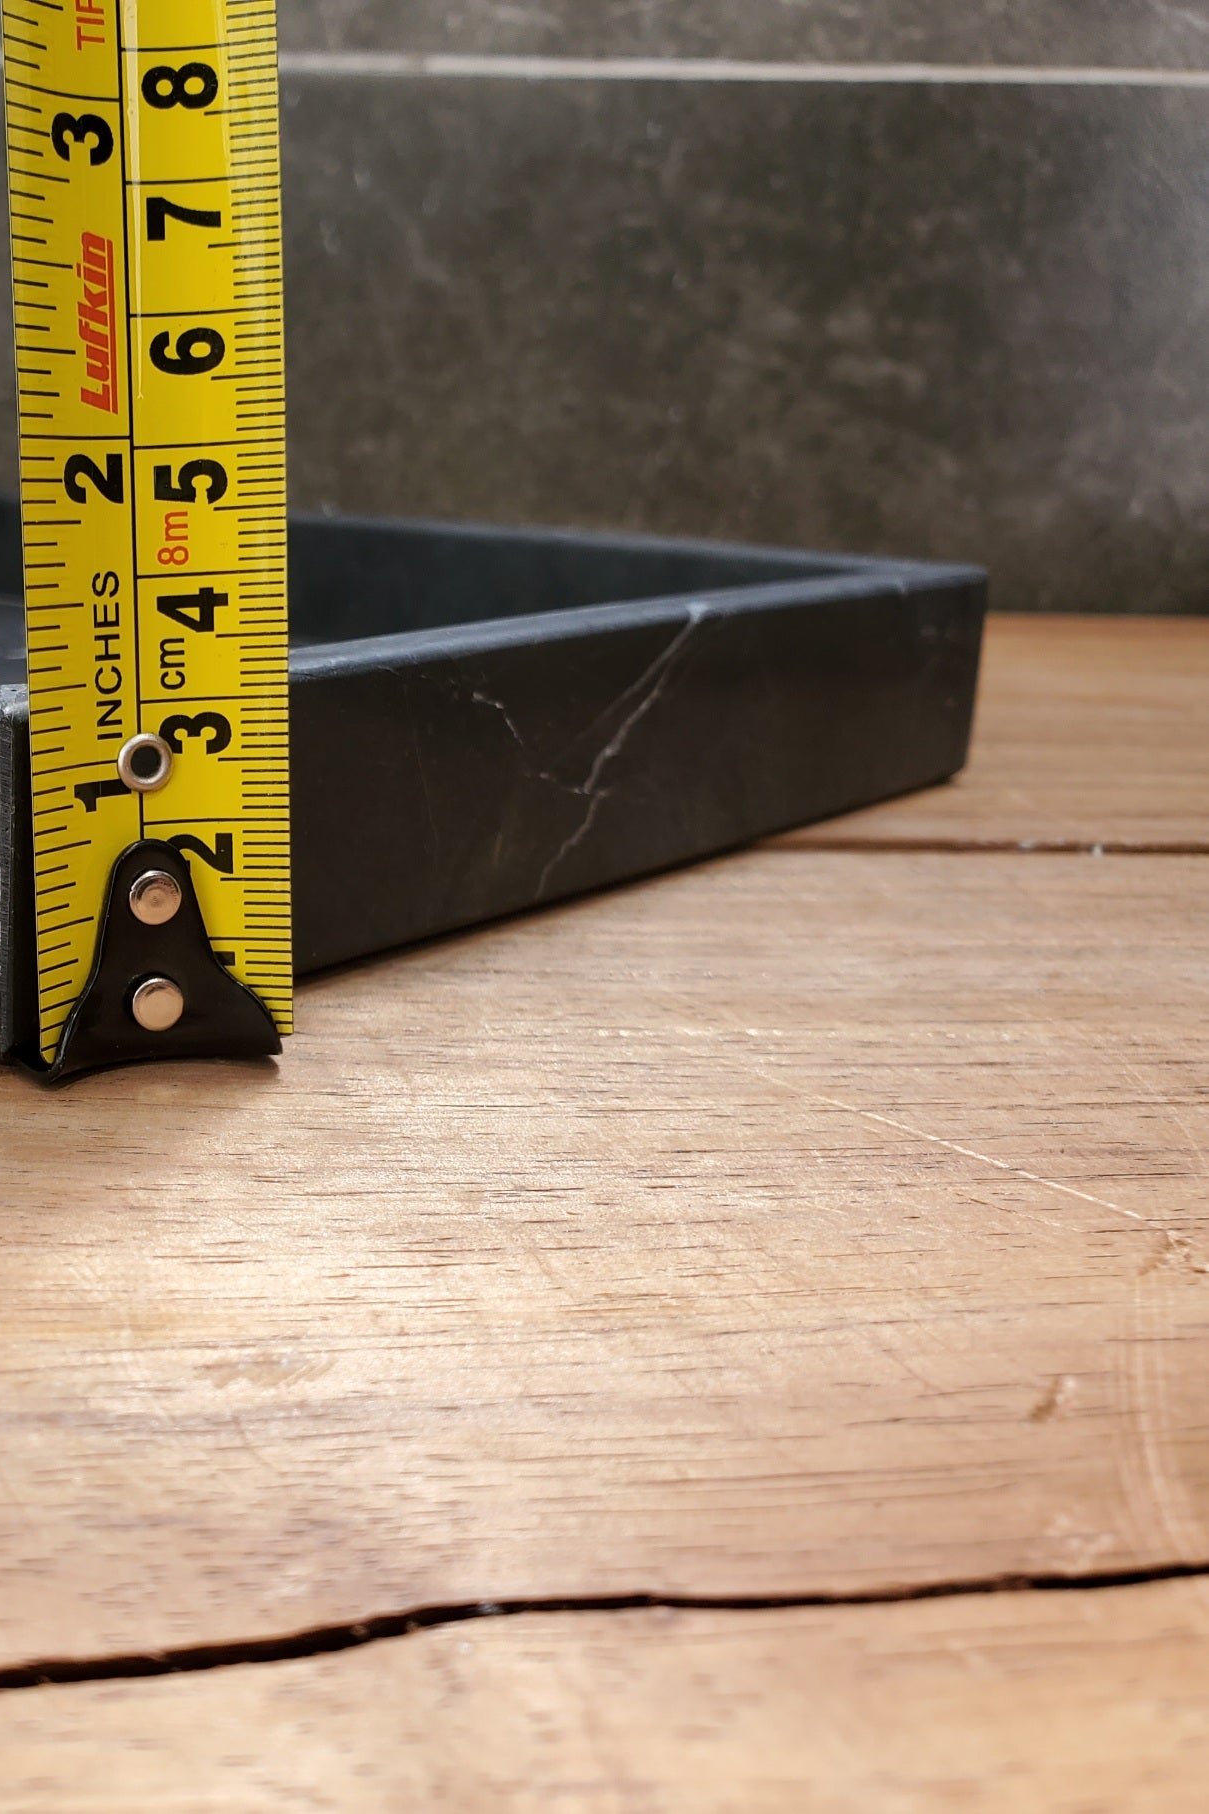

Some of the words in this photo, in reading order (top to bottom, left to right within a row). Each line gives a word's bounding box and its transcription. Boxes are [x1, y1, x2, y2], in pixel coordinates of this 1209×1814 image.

[141, 62, 219, 110] 8
[51, 112, 115, 166] 3
[146, 197, 222, 242] 7
[76, 231, 117, 415] Lufkin
[149, 327, 226, 376] 6
[63, 453, 124, 505] 2
[153, 459, 228, 505] 5
[157, 511, 189, 567] 8m
[156, 586, 229, 633] 4
[92, 570, 123, 741] INCHES
[159, 637, 186, 690] cm
[158, 711, 233, 755] 3
[74, 778, 133, 813] 1
[166, 832, 234, 875] 2
